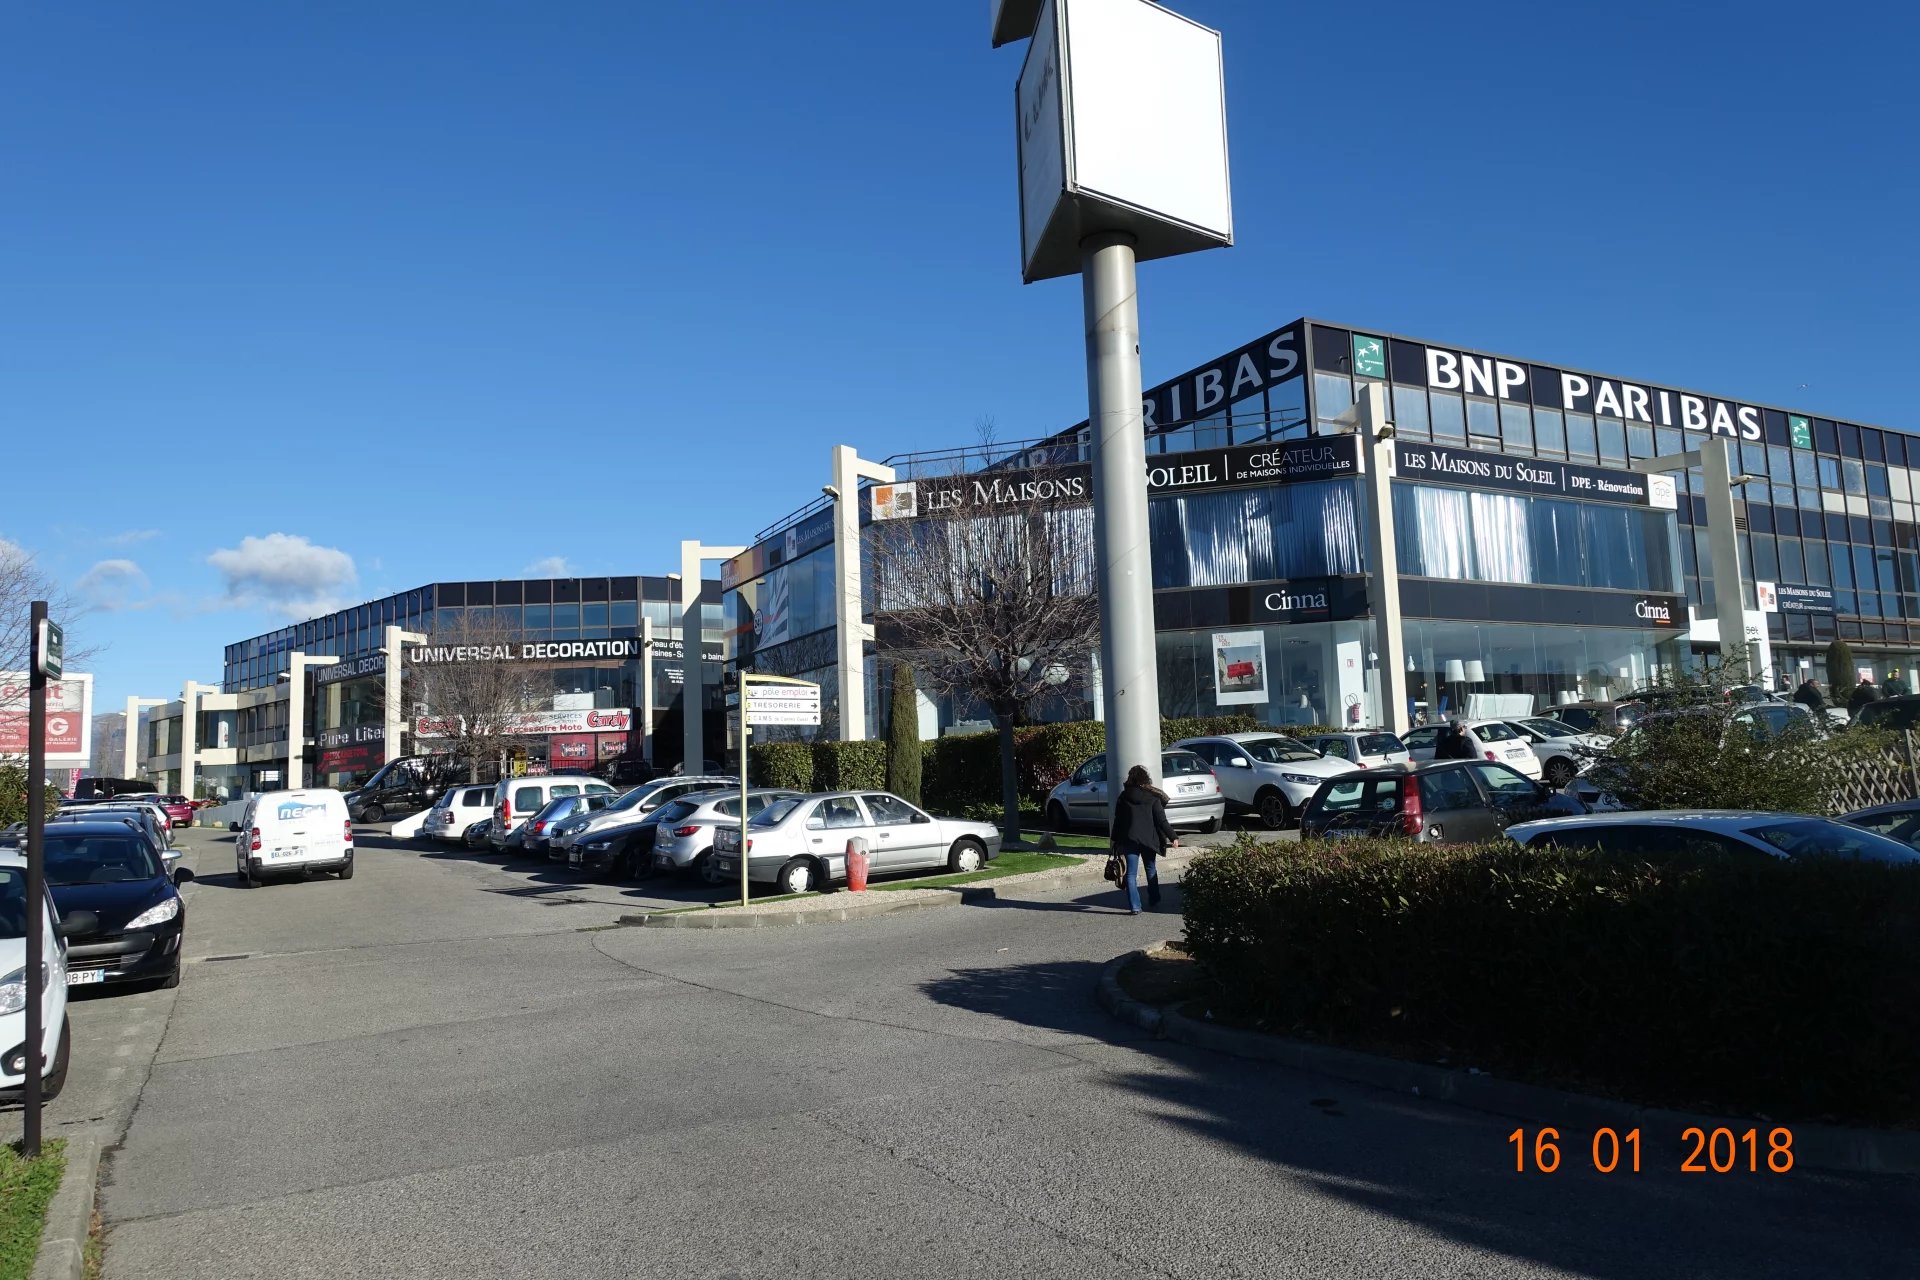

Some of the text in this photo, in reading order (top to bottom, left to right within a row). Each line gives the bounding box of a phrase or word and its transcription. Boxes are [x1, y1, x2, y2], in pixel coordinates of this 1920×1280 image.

[1426, 348, 1761, 441] BNP PARIBAS
[1249, 446, 1335, 468] CRÉATEUR
[1236, 460, 1351, 480] DE MAISONS INDIVIDUELLES
[1404, 451, 1556, 486] LES MAISONS DU SOLEIL
[926, 462, 1217, 510] LES MAISONS OLEIL
[1572, 475, 1592, 489] DPE
[1597, 478, 1643, 496] Rénovation
[1264, 589, 1328, 611] Cinna
[1777, 586, 1833, 598] LES MAISONS DU SOLEIL
[1635, 600, 1670, 620] Cinna
[411, 640, 638, 663] UNIVERSAL DECORATION
[317, 661, 357, 683] UNIVERSAL
[762, 687, 808, 697] pôle emploi
[559, 723, 583, 731] Moto
[320, 732, 349, 747] Pure
